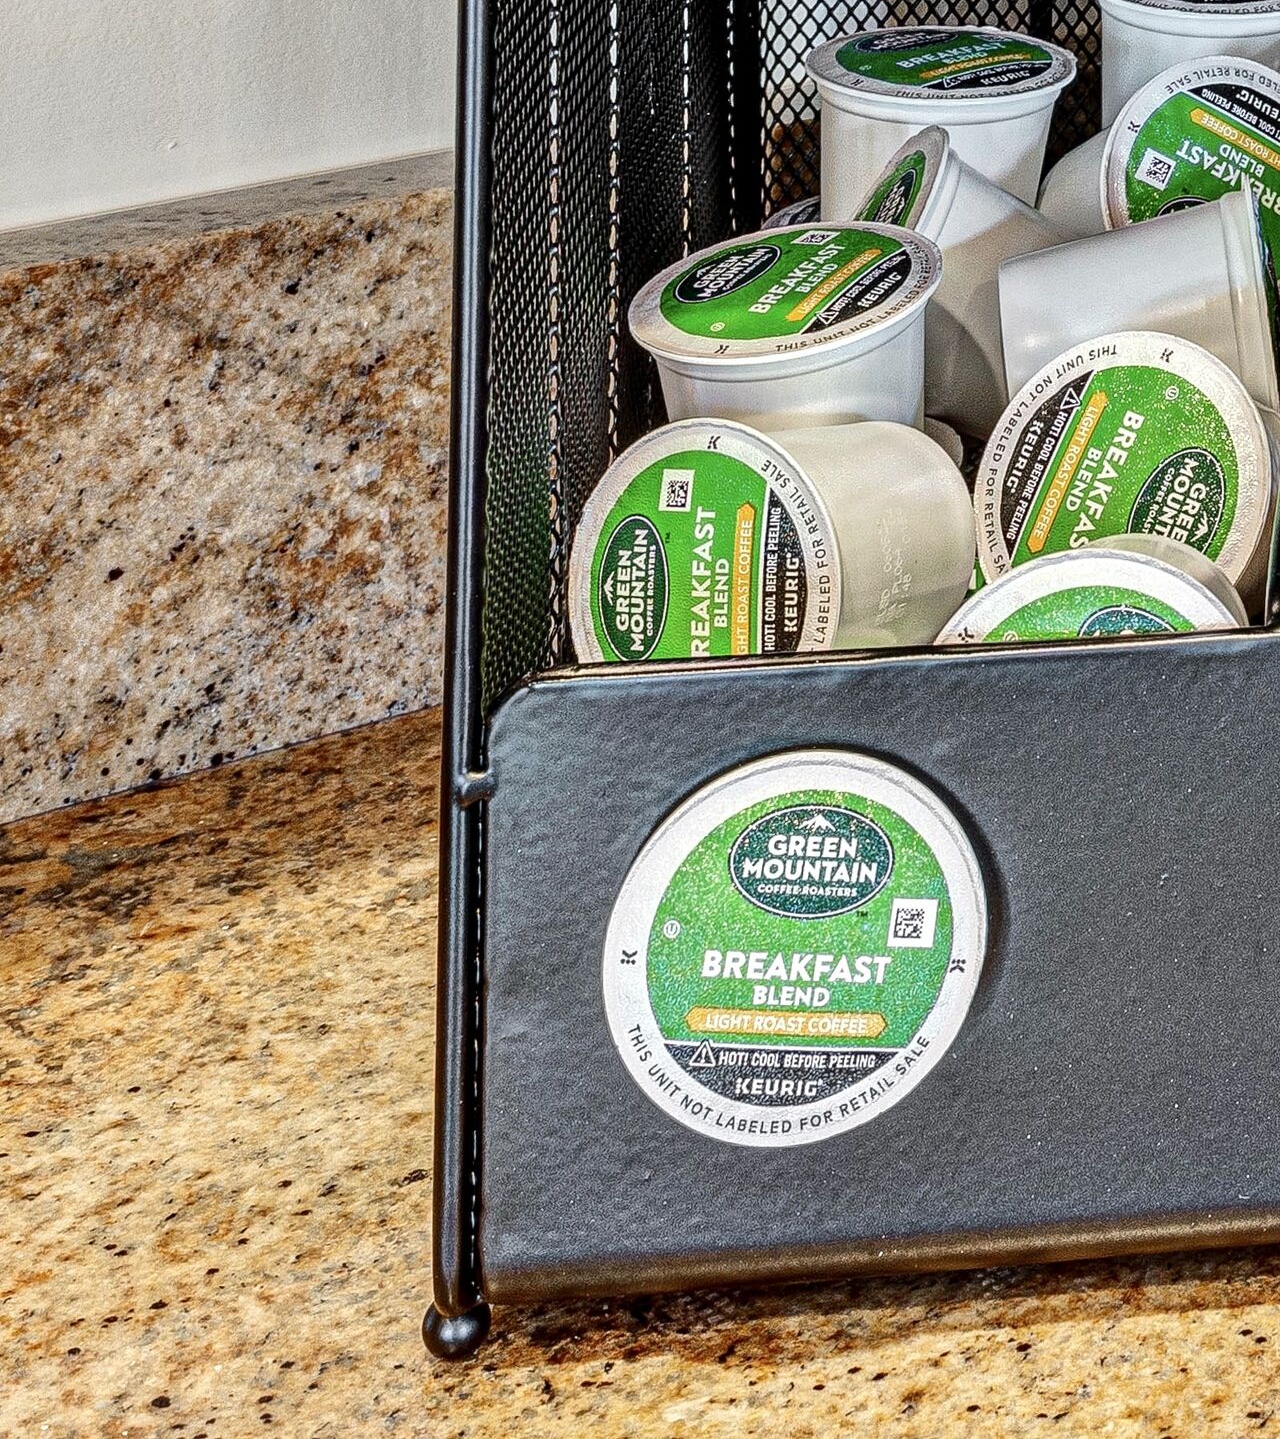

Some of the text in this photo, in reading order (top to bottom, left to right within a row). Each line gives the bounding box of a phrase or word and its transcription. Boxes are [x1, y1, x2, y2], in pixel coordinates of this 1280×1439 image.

[981, 70, 1031, 85] KEURIG
[1165, 74, 1191, 95] SALE
[1194, 67, 1230, 81] RETAIL
[1235, 69, 1255, 80] FOR
[1219, 144, 1265, 177] BLEND
[697, 248, 774, 298] MOUNTAIN
[748, 243, 846, 313] BREAKFAST
[794, 263, 838, 293] BLEND
[858, 274, 902, 308] KEURIG
[985, 344, 1118, 552] THIS UNIT NOT LABELED FOR RETAIL
[1006, 419, 1045, 494] KEURIG
[1065, 447, 1098, 511] BLEND
[1069, 410, 1145, 548] BREAKFAS
[1172, 483, 1206, 543] GREE
[736, 520, 753, 625] ROAST COFFEE
[761, 459, 831, 644] LABELED FOR RETAIL SALE
[765, 507, 781, 622] COOL BEFORE PEELING
[616, 550, 632, 631] GREEN
[630, 529, 649, 652] MOUNTAIN
[691, 506, 716, 657] REAKFAST
[714, 559, 729, 627] BLEND
[784, 553, 799, 632] KEURIG
[743, 859, 878, 883] MOUNTAIN
[768, 834, 858, 858] GREEN
[757, 884, 858, 897] COFFEE ROASTERS
[701, 950, 891, 984] BREAKFAST
[752, 986, 831, 1007] BLEND
[706, 1012, 866, 1033] LIGHT ROAST COFFEE
[627, 1024, 931, 1134] THIS UNIT NOT LABELED FOR RETAIL SALE
[719, 1049, 876, 1069] HOT! COOL BEFORE PEELING
[735, 1076, 822, 1096] KEURIG
